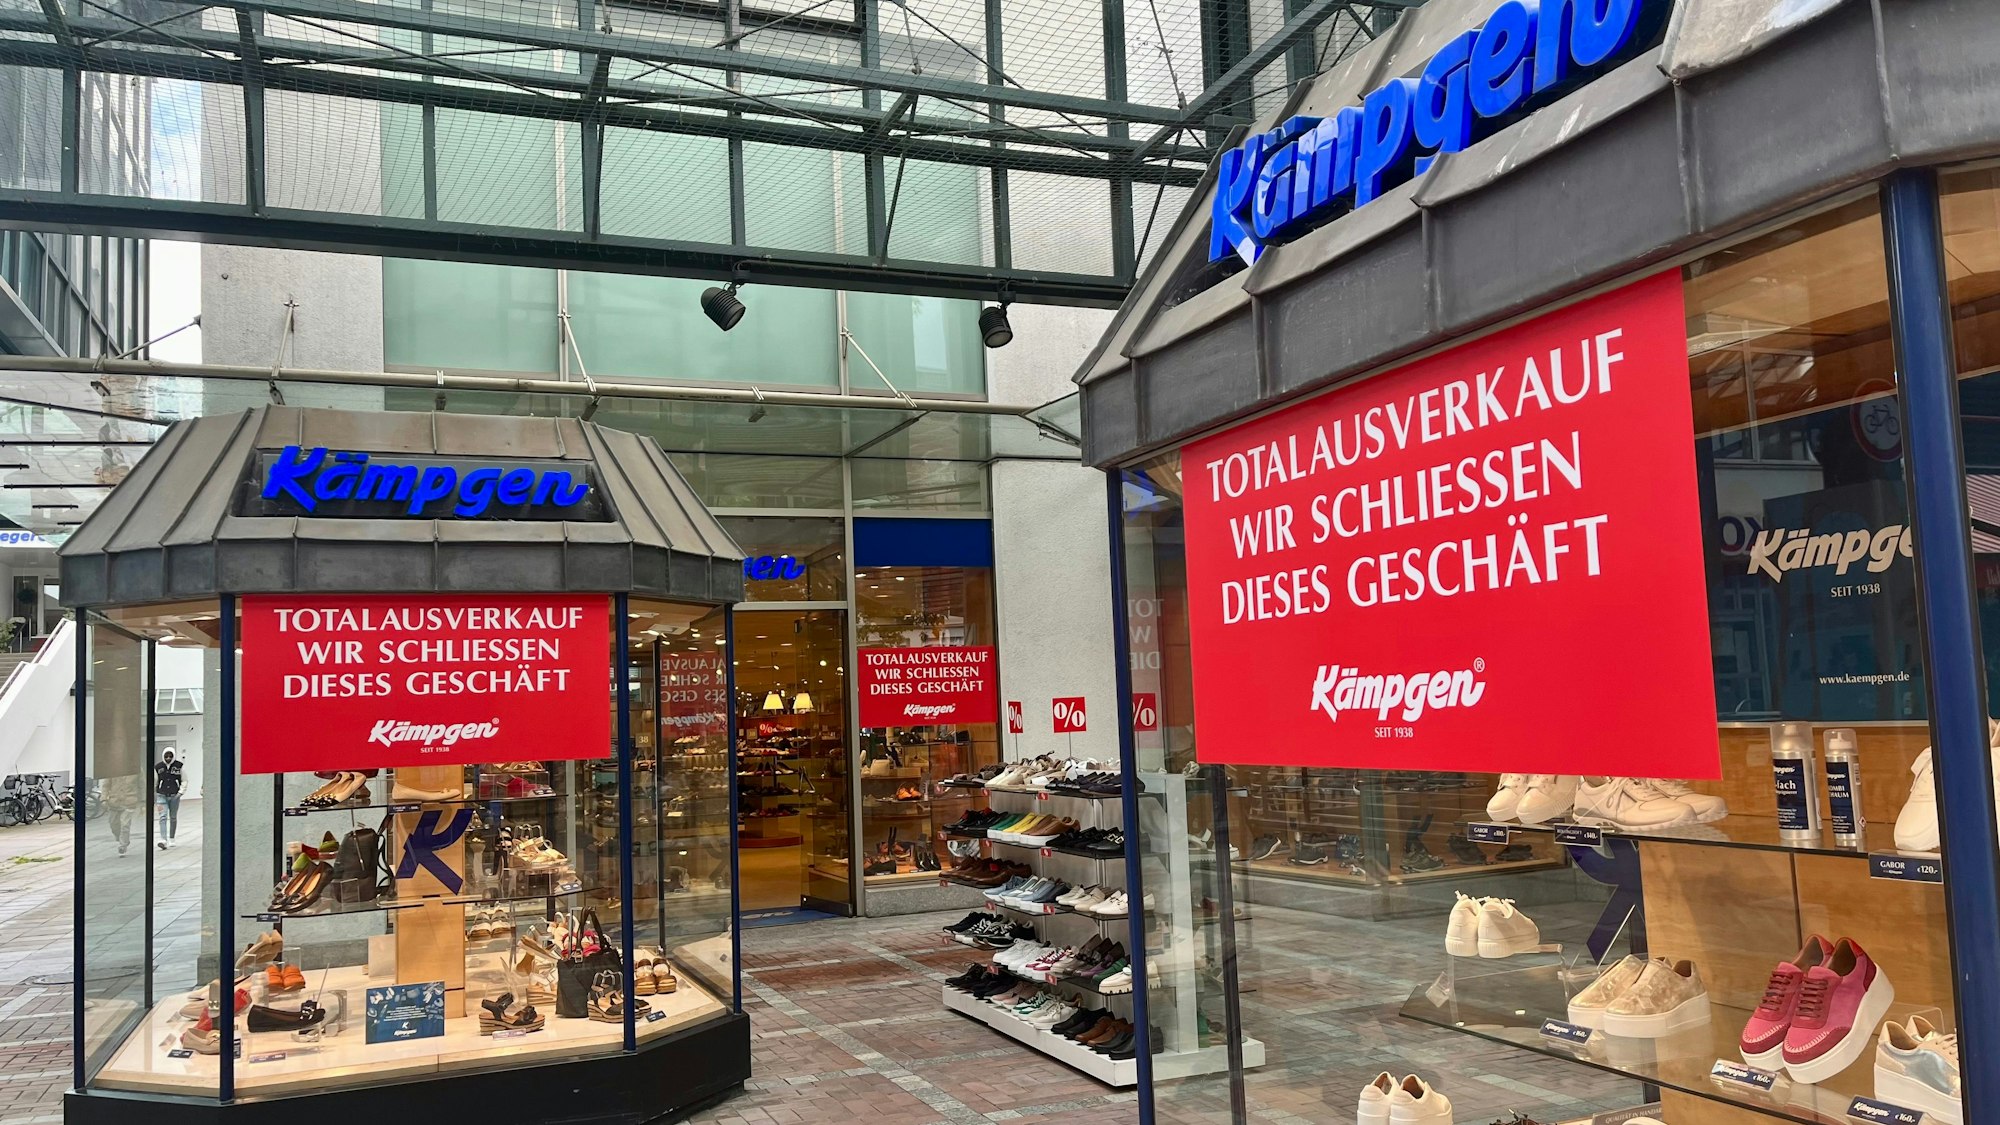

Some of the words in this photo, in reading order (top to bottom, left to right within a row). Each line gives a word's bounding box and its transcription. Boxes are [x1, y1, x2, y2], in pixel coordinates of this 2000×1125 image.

[1208, 0, 1641, 267] Kämpgen
[1206, 328, 1625, 502] TOTALAUSVERKAUF
[260, 445, 590, 517] Kämpgen
[1229, 504, 1297, 560] WIR
[1312, 431, 1583, 544] SCHLIESSEN
[1221, 564, 1331, 625] DIESES
[1346, 513, 1609, 607] GESCHÄFT
[1830, 586, 1853, 598] SEIT
[1856, 583, 1881, 595] 1938
[274, 606, 583, 633] TOTALAUSVERKAUF
[298, 639, 364, 666] WIR
[378, 638, 560, 664] SCHLIESSEN
[866, 651, 988, 665] TOTALAUSVERKAUF
[283, 671, 392, 699] DIESES
[406, 665, 570, 696] GESCHÄFT
[870, 683, 913, 695] DIESES
[917, 678, 984, 694] GESCHÄFT
[875, 668, 901, 680] WIR
[906, 666, 979, 679] SCHLIESSEN
[1819, 671, 1910, 686] www.kaempgen.de
[1374, 727, 1392, 738] SEIT
[1394, 726, 1414, 738] 1938
[1880, 860, 1905, 869] GABOR
